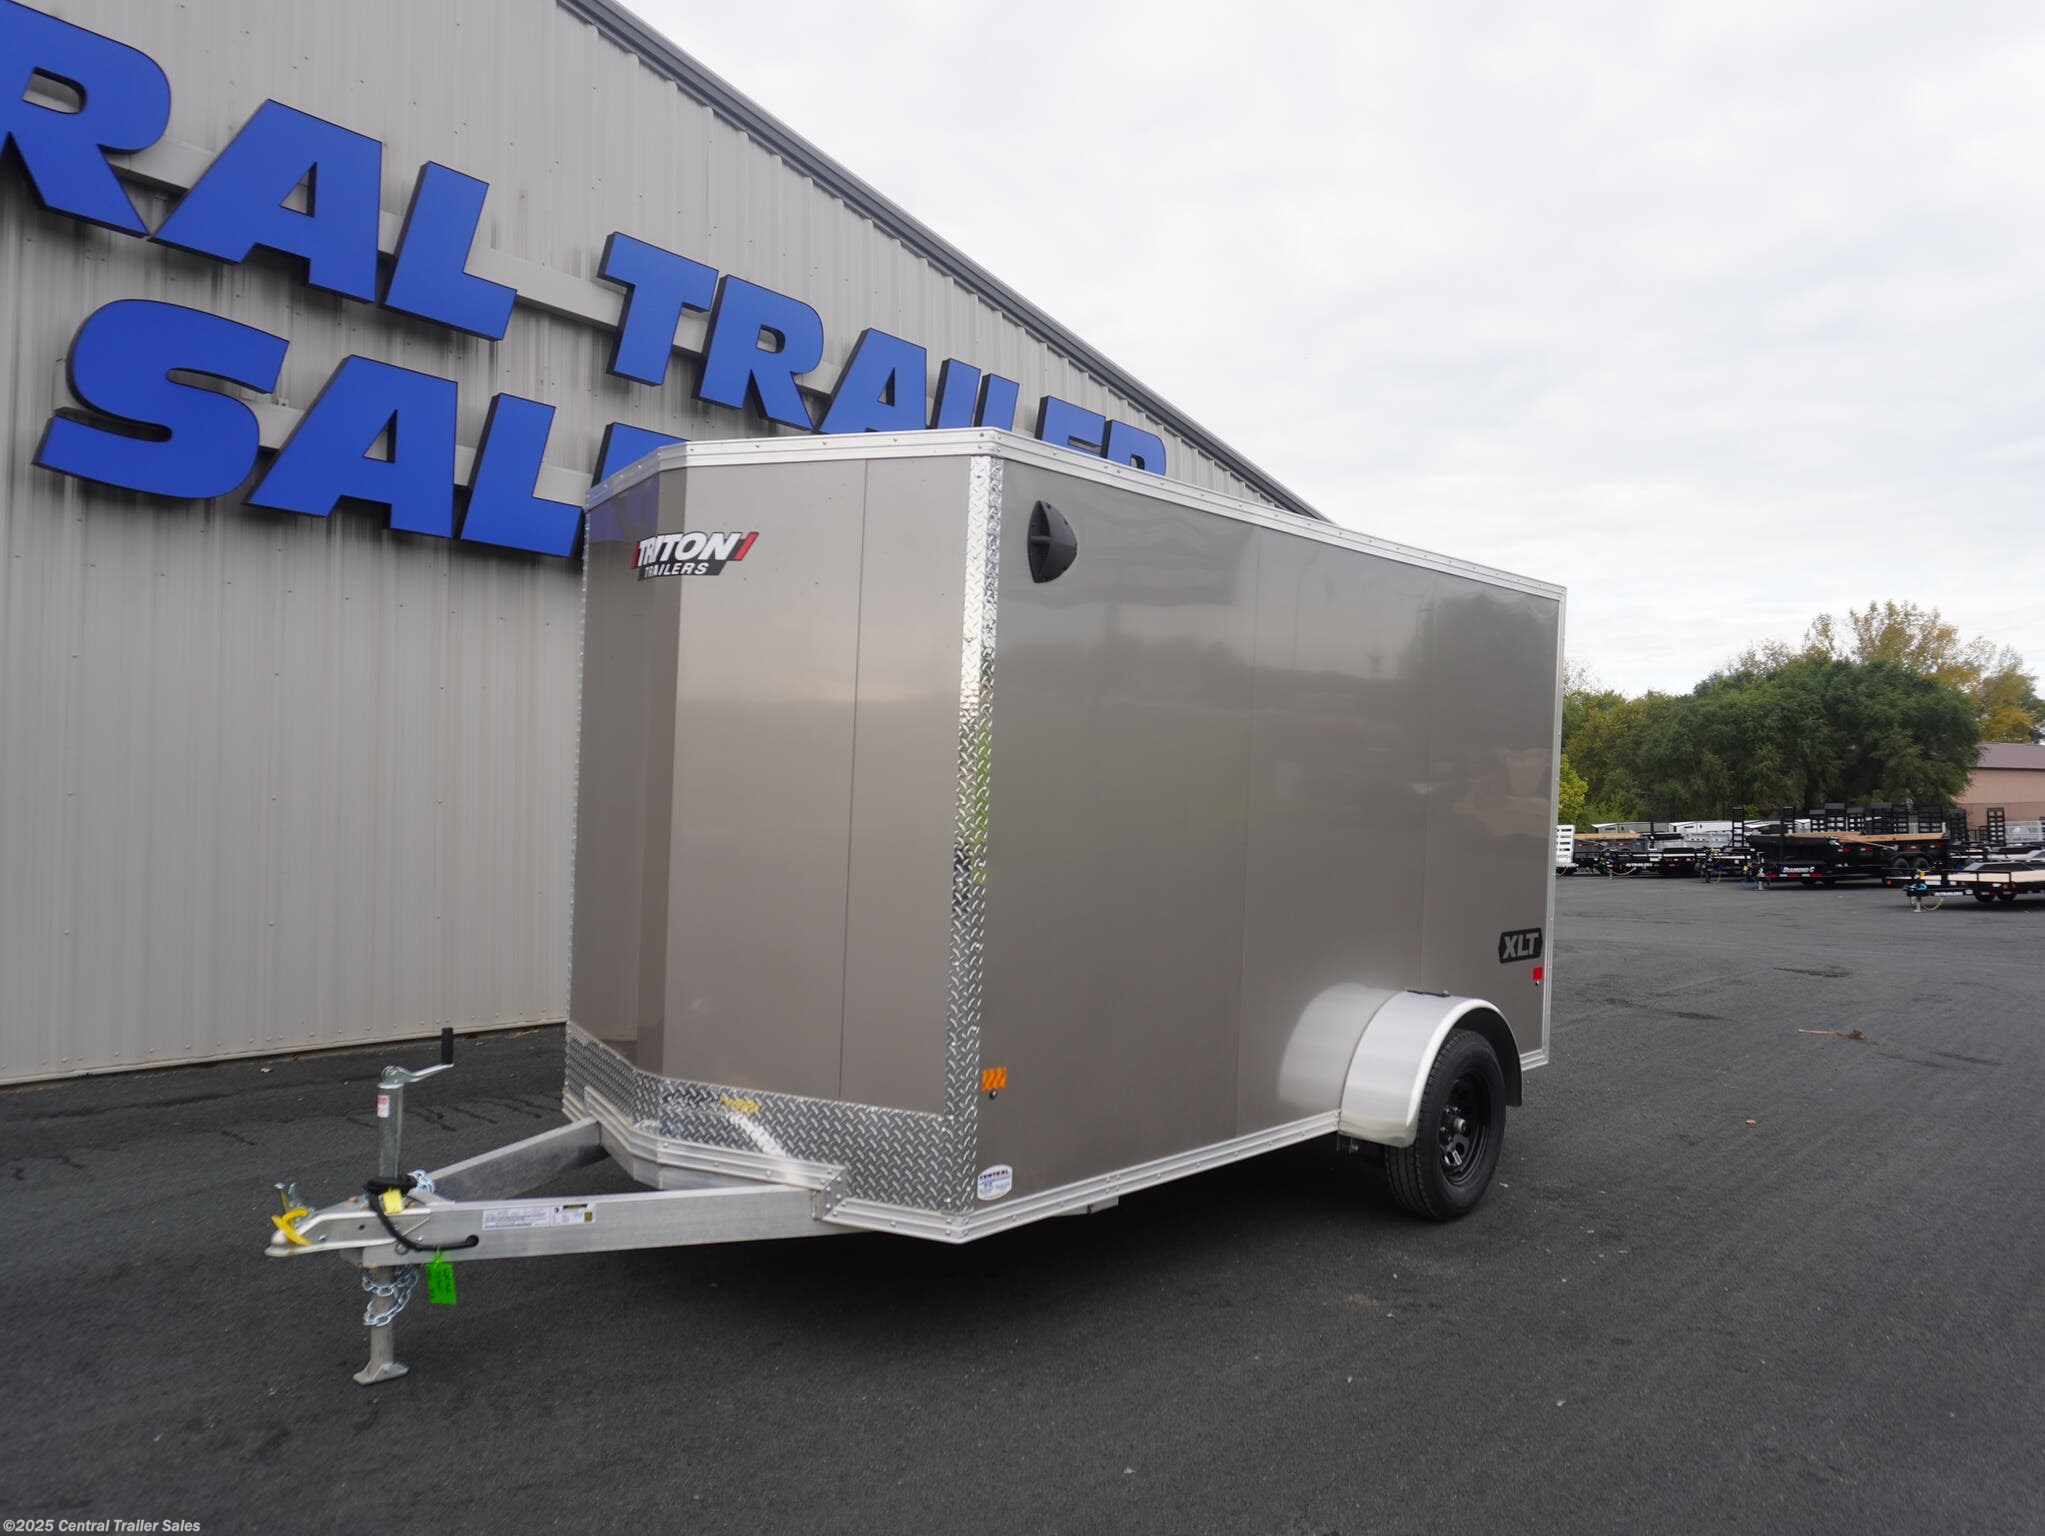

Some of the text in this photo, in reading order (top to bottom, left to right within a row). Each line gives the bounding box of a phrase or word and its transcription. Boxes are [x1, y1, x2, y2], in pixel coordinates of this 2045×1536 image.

[637, 531, 741, 567] TRITON
[643, 562, 709, 579] TRAILERS
[1502, 931, 1540, 959] XLT
